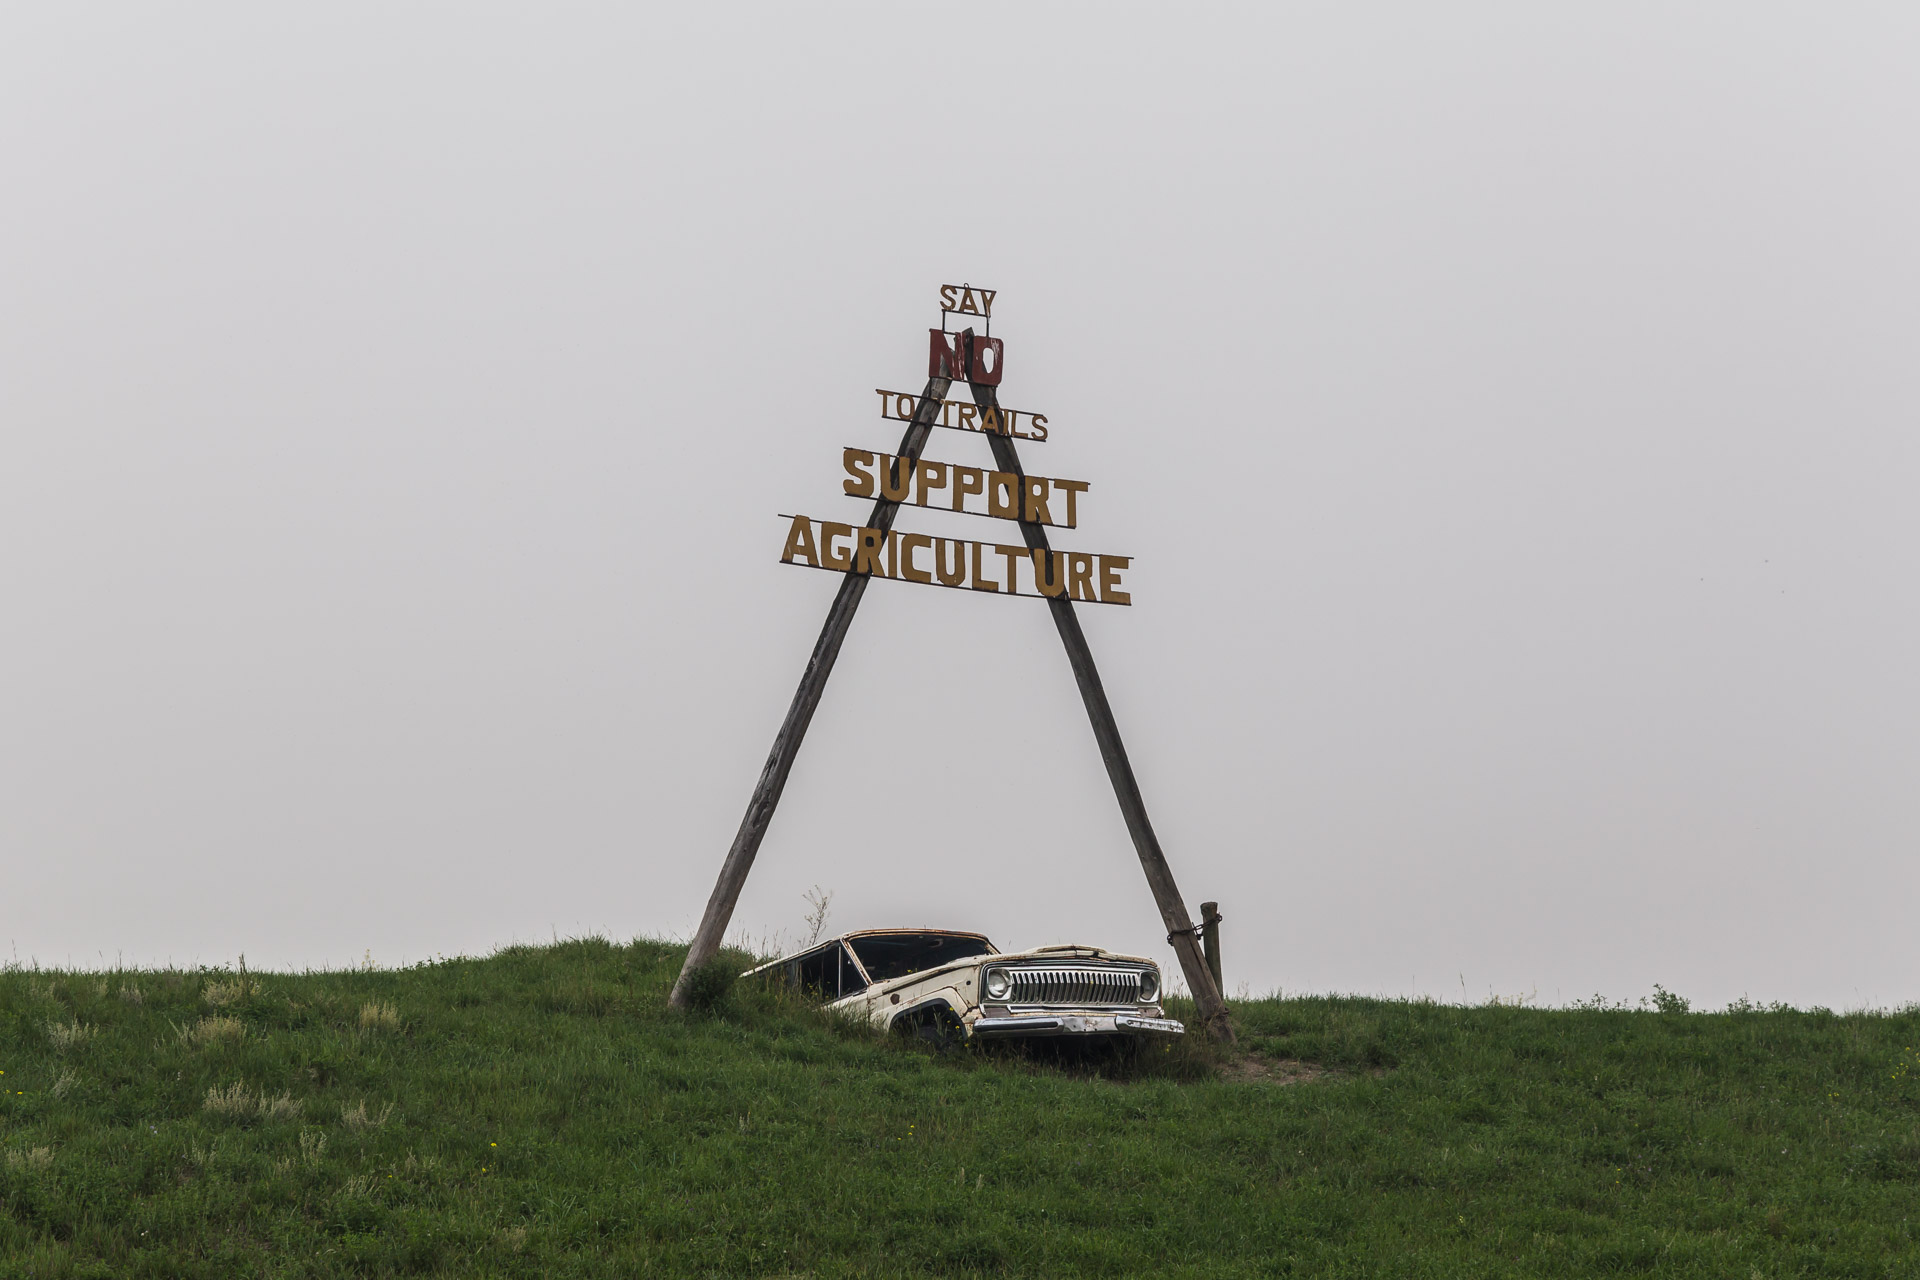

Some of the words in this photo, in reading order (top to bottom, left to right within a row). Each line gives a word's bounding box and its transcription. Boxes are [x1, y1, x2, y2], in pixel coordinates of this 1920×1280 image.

[940, 285, 996, 317] SAY
[929, 329, 1004, 386] NO
[877, 390, 915, 420] TO
[940, 399, 1048, 440] TRAILS
[843, 449, 1089, 528] SUPPORT
[781, 515, 1132, 604] AGRICULTURE
